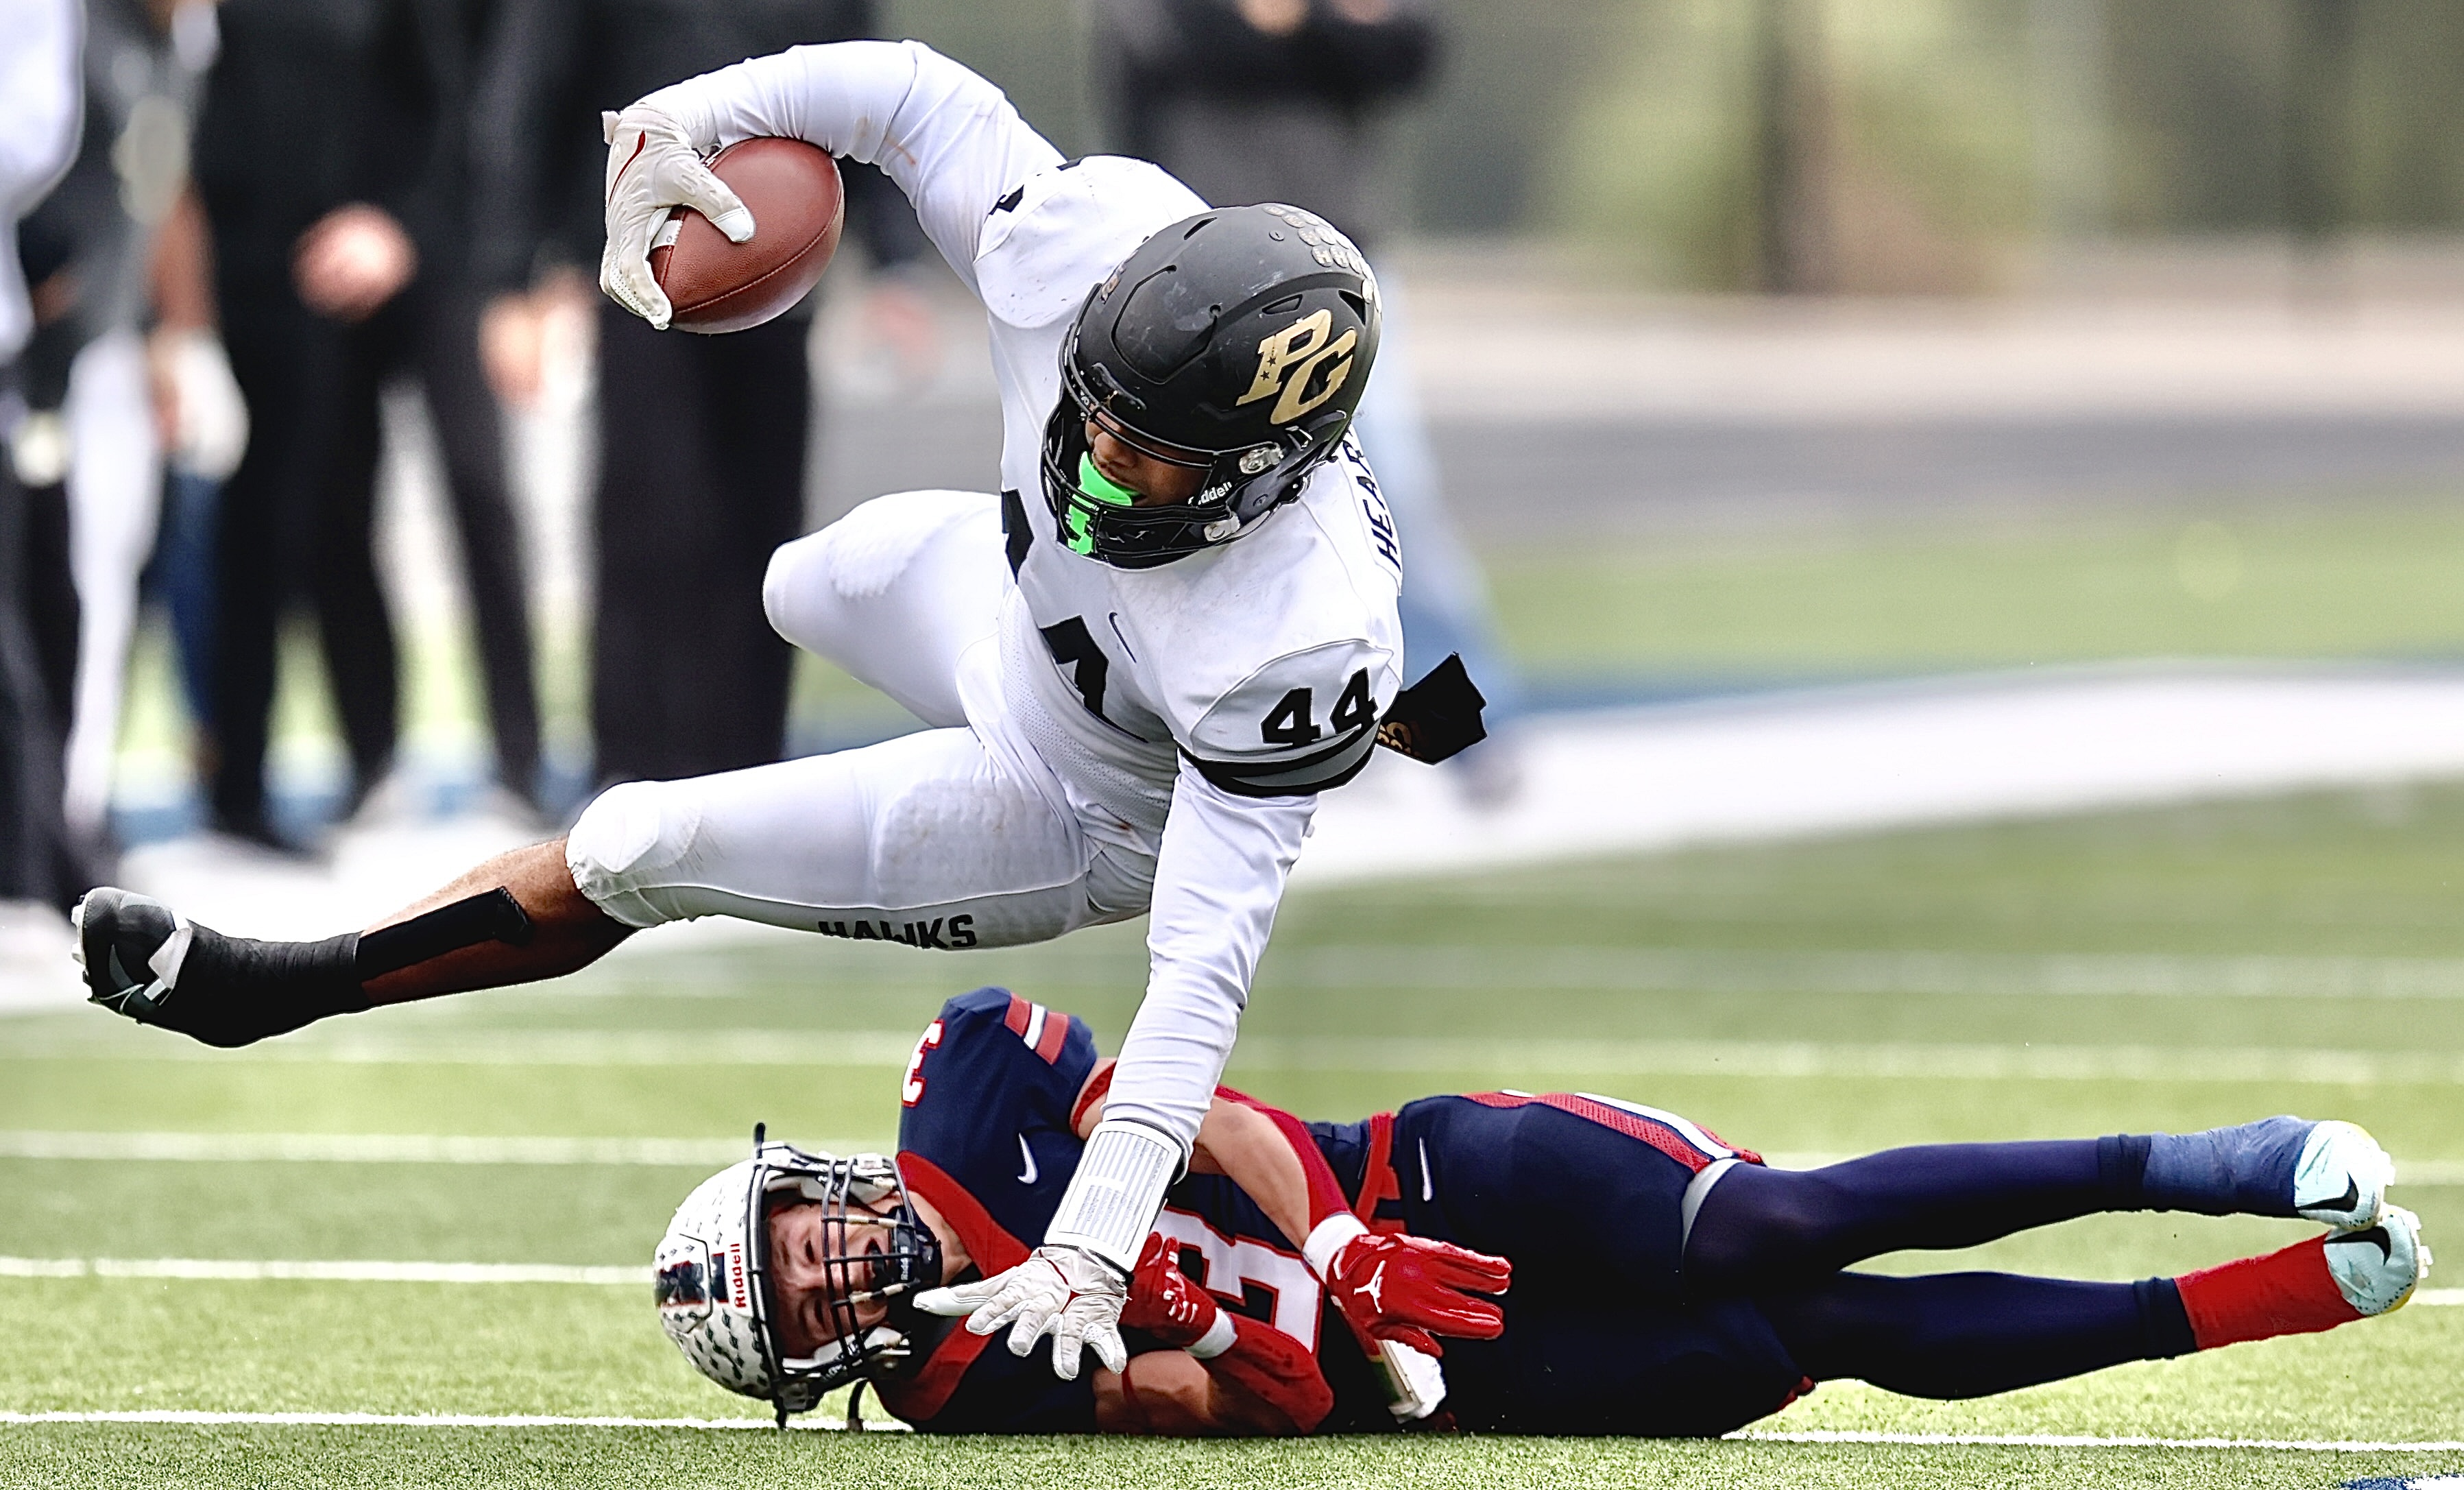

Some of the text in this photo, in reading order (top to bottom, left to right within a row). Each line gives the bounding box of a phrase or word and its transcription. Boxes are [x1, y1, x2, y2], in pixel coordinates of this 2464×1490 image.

[1235, 308, 1357, 425] PG
[1187, 481, 1233, 505] ddell
[1342, 430, 1401, 573] HEAR
[1260, 666, 1379, 747] 44
[818, 914, 977, 949] HAWKS
[729, 1243, 747, 1308] Riddell
